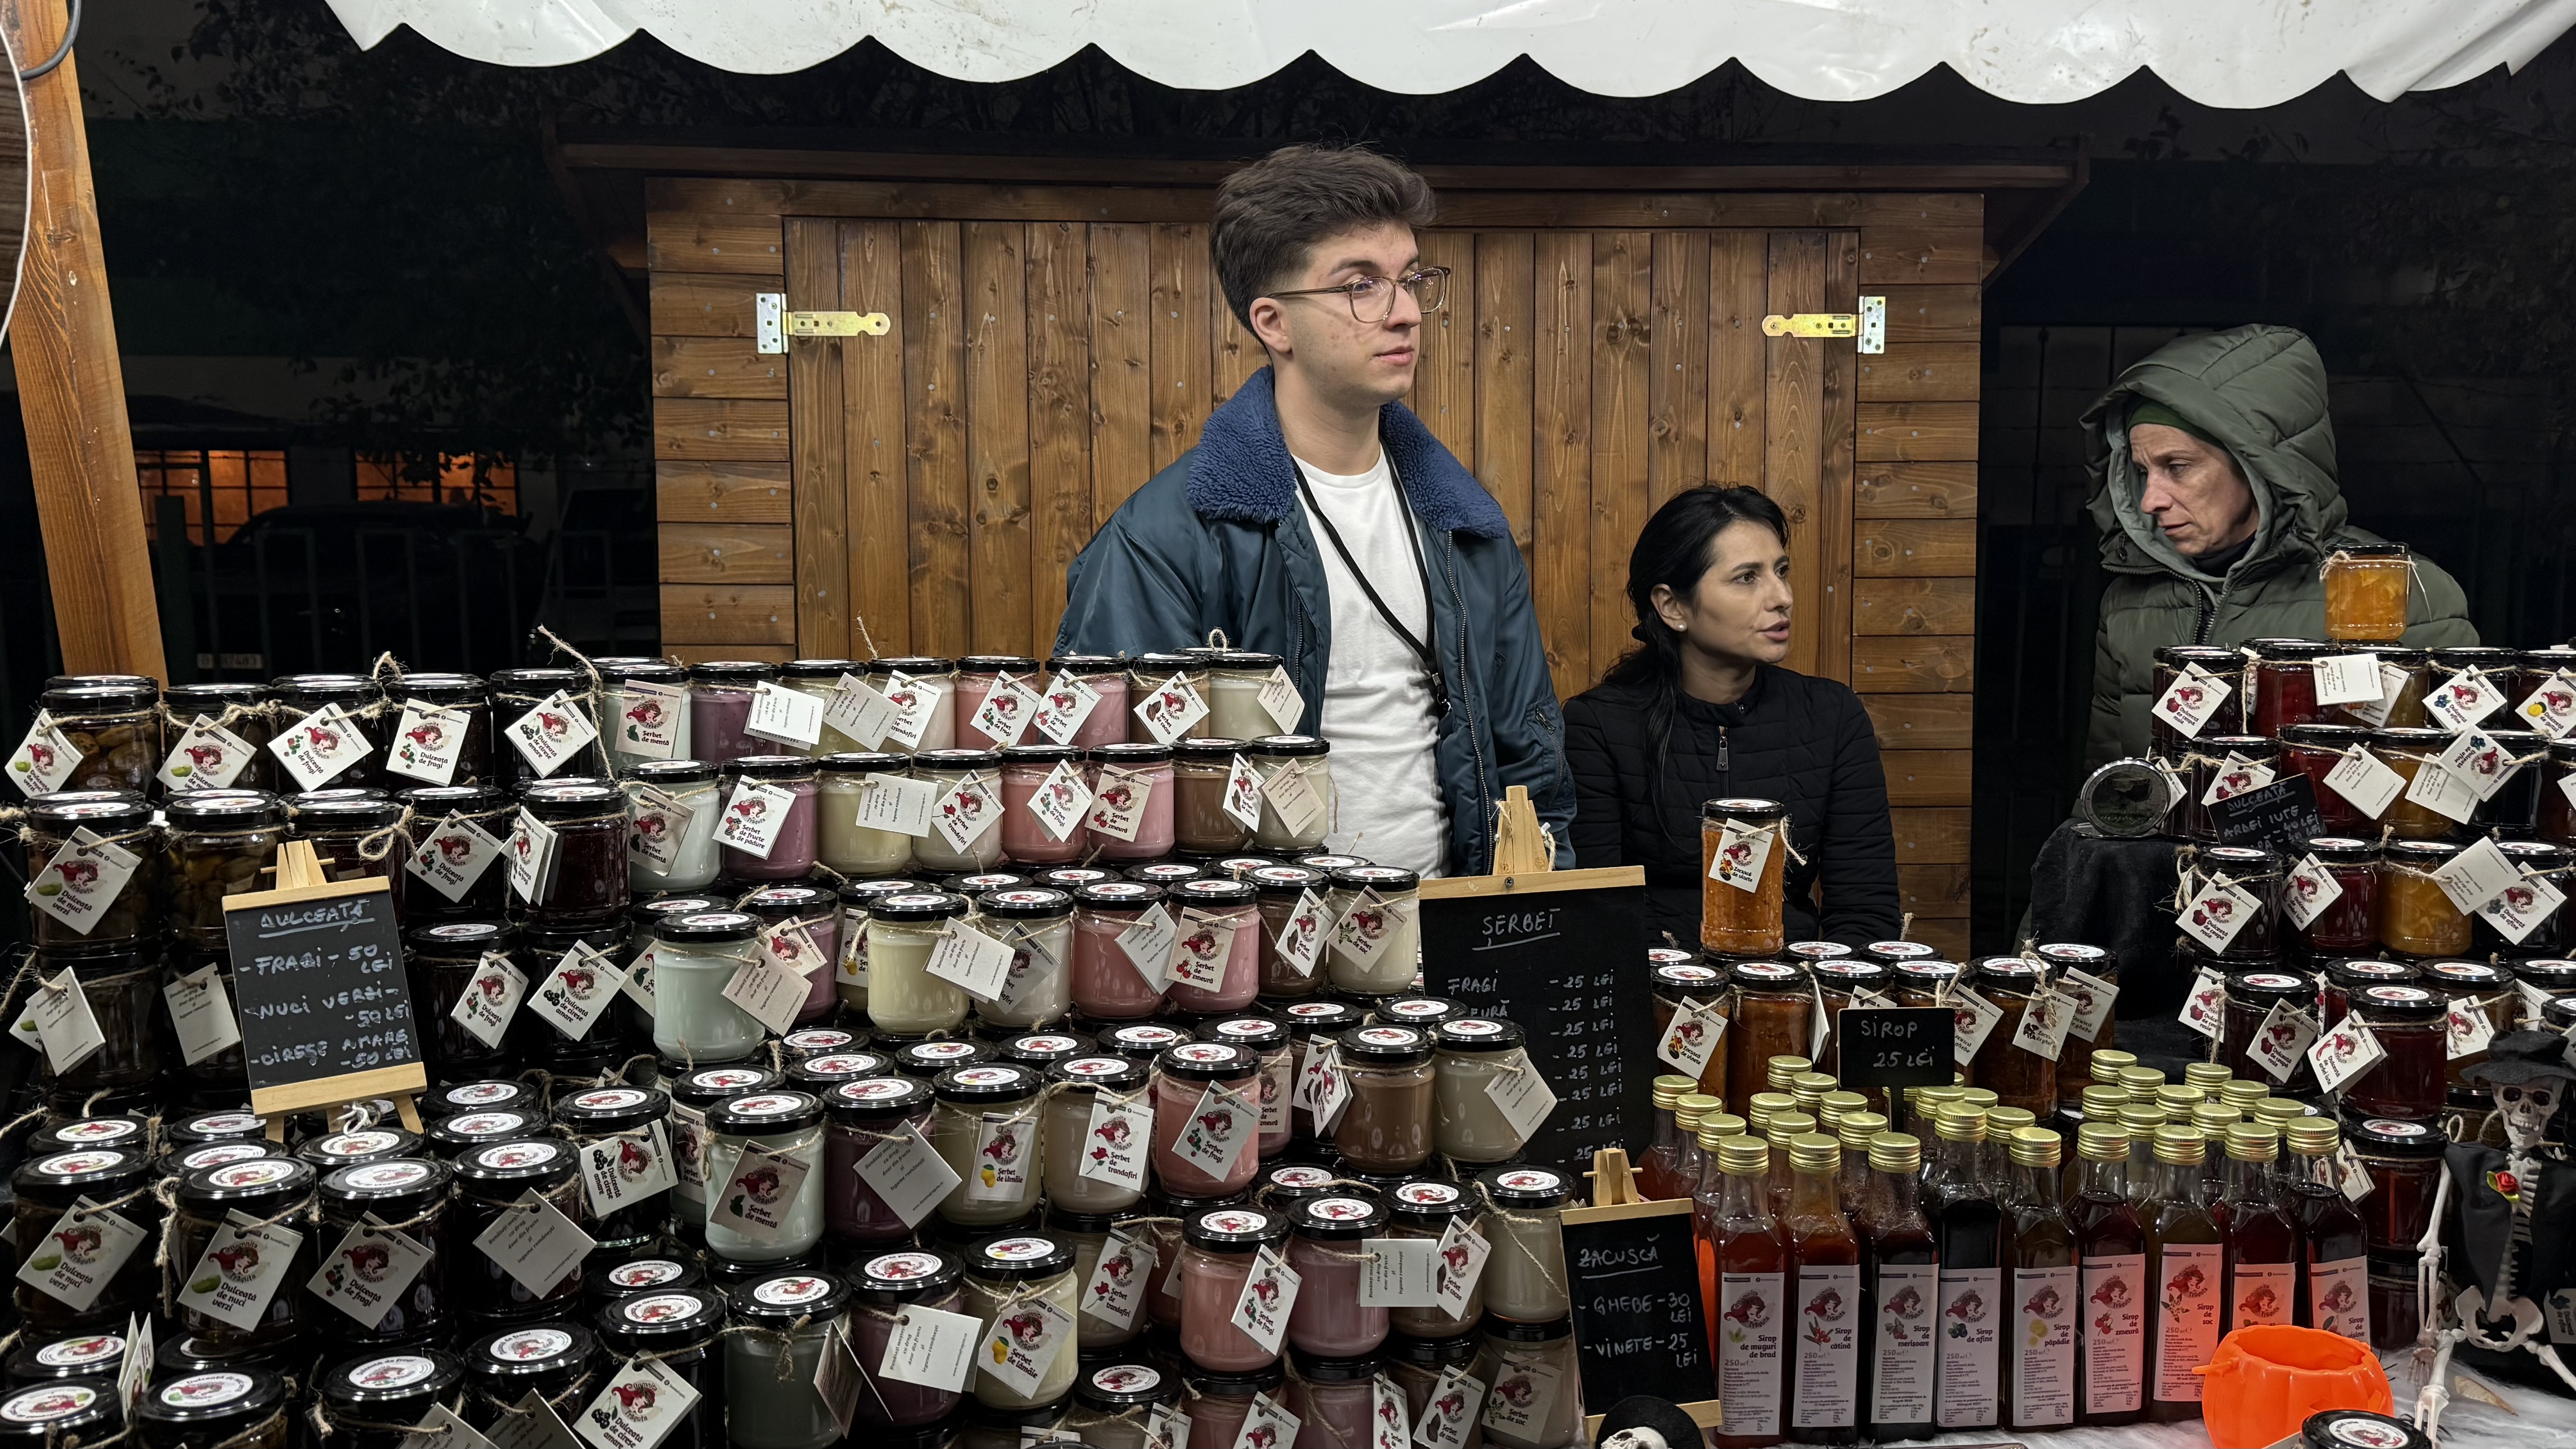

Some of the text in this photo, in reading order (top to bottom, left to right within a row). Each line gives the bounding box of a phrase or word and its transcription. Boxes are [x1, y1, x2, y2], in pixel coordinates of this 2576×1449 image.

[349, 944, 377, 960] 50
[1563, 975, 1584, 988] 25
[1593, 969, 1613, 987] LEI
[1561, 997, 1581, 1010] 25
[1593, 990, 1612, 1009] LEI
[1563, 1012, 1613, 1036] 25 LEI
[1861, 1016, 1917, 1038] SIROP
[1567, 1036, 1617, 1058] 25 LEI
[1569, 1057, 1621, 1079] 25 LEI
[1873, 1052, 1902, 1067] 25
[1572, 1078, 1622, 1100] 25 LEI
[1571, 1106, 1620, 1130] 25 LEI
[1573, 1145, 1593, 1161] 25
[216, 1290, 227, 1299] de
[344, 1287, 354, 1295] de
[1669, 1333, 1688, 1351] 25
[1758, 1335, 1776, 1343] Sirop
[1007, 1357, 1014, 1365] de
[1675, 1348, 1697, 1367] LEI
